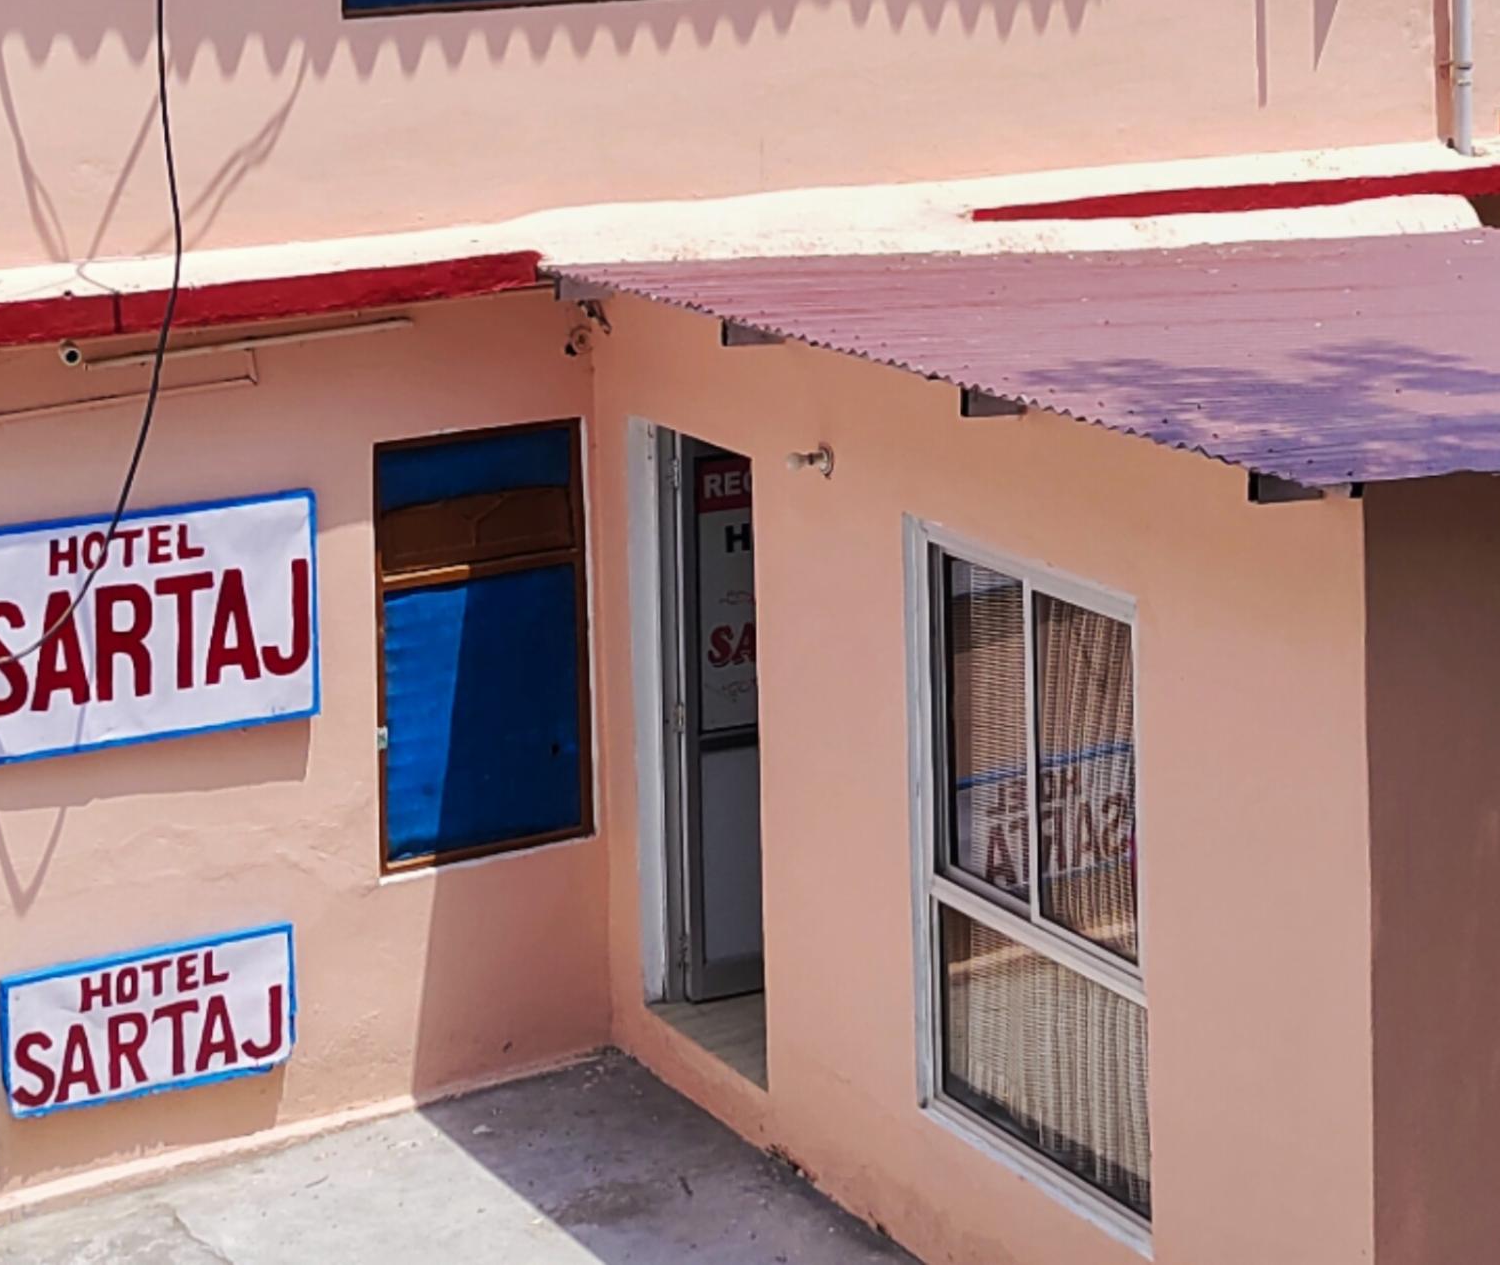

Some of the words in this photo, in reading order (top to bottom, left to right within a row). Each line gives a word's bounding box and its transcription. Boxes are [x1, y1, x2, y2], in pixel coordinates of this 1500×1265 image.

[48, 523, 205, 576] HOTEL
[79, 949, 230, 1013] HOTEL
[11, 984, 283, 1107] SARTAJ
